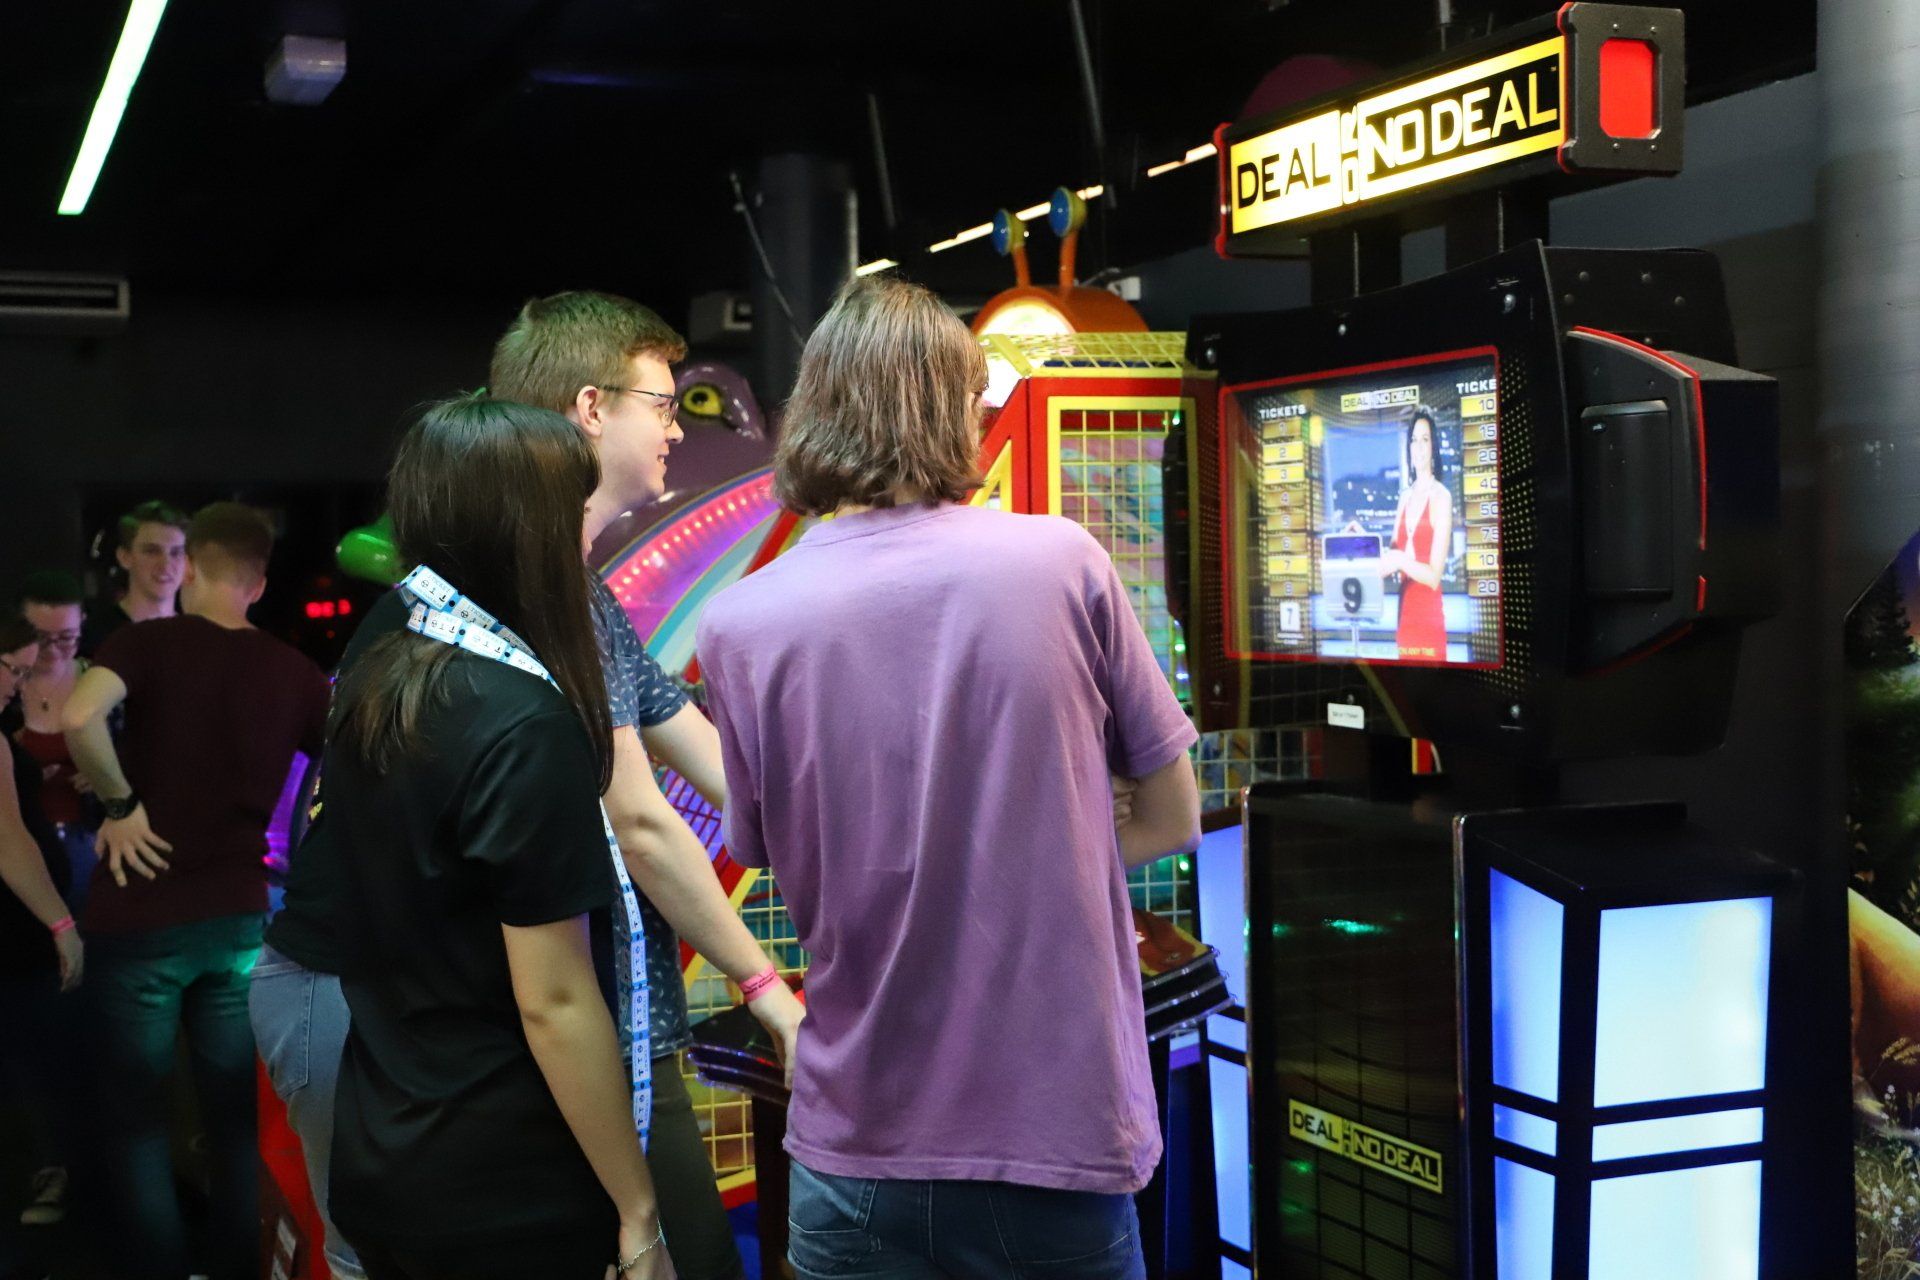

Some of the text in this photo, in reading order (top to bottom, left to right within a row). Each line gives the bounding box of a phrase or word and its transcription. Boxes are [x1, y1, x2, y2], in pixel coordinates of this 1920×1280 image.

[1237, 142, 1331, 209] DEAL
[1362, 108, 1425, 174] NO
[1431, 72, 1558, 156] DEAL
[1259, 404, 1307, 419] TICKETS
[1479, 399, 1495, 411] 10
[1479, 425, 1496, 439] 15
[1279, 447, 1287, 459] 2
[1479, 448, 1498, 462] 20
[1280, 468, 1288, 480] 3
[1342, 577, 1362, 614] 9
[1286, 607, 1293, 625] 7
[1292, 1109, 1338, 1144] DEAL
[1353, 1129, 1381, 1161] NO
[1383, 1143, 1438, 1184] DEAL
